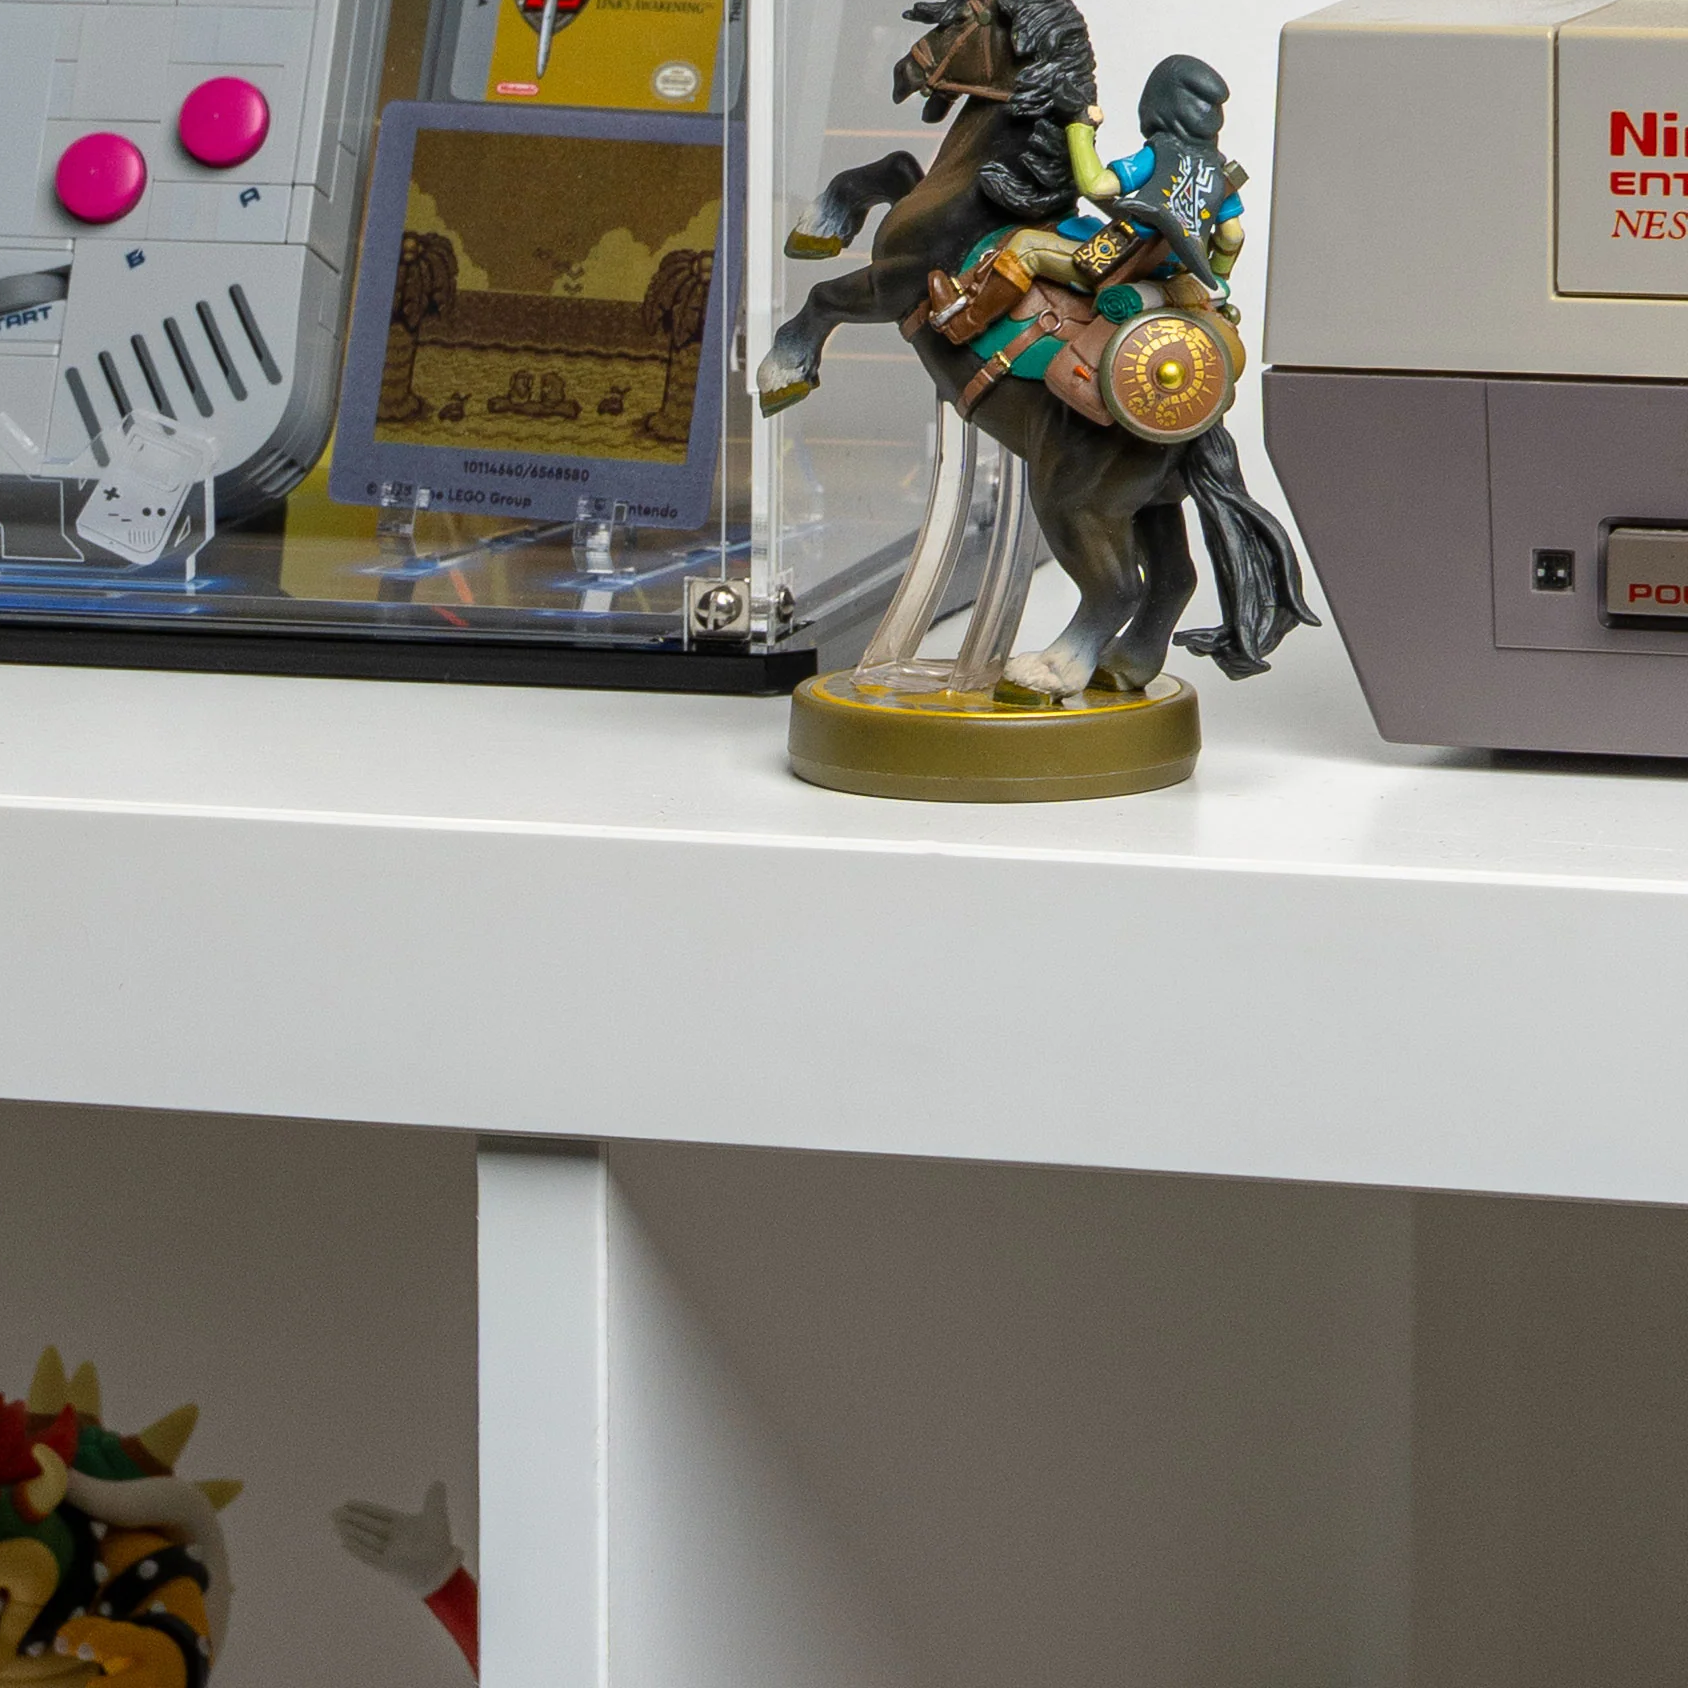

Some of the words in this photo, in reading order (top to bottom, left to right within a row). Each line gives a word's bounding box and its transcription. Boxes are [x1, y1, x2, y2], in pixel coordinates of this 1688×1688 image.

[1609, 110, 1688, 158] Ni
[238, 186, 261, 208] A
[1611, 209, 1688, 240] NES
[125, 247, 146, 269] B
[447, 488, 486, 503] LEGO
[490, 493, 533, 509] Group
